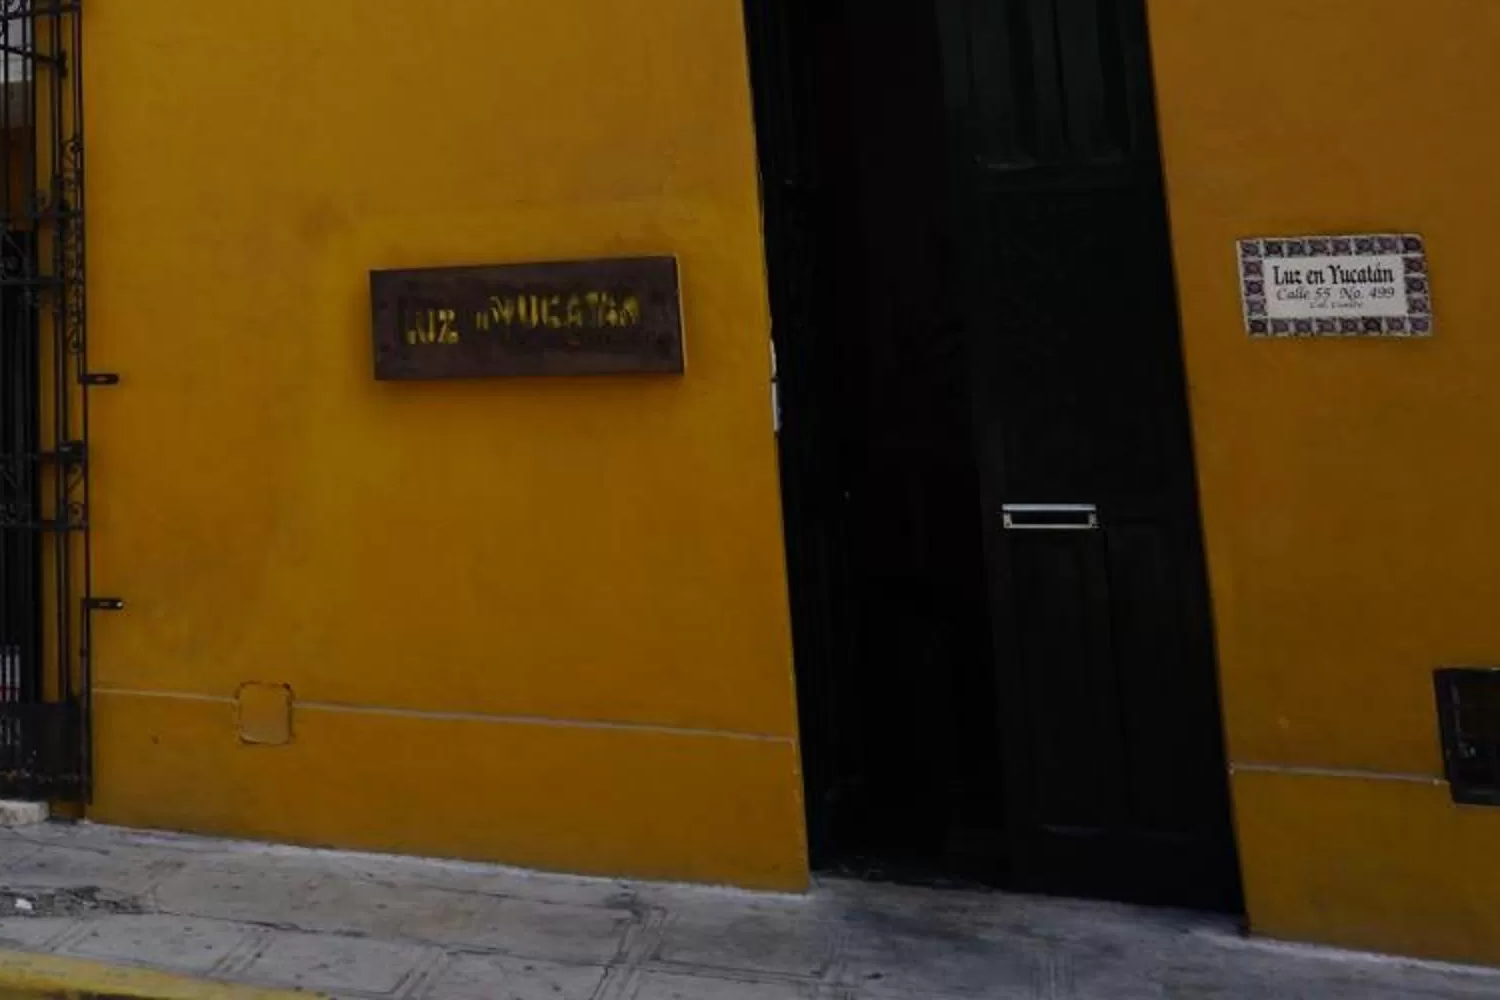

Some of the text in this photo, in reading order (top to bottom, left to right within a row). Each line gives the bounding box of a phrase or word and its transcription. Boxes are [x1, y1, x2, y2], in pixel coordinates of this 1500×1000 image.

[1273, 262, 1394, 285] Luz en Yucatán
[1276, 287, 1310, 301] Calle
[1315, 287, 1331, 299] 55
[1369, 286, 1395, 299] 499
